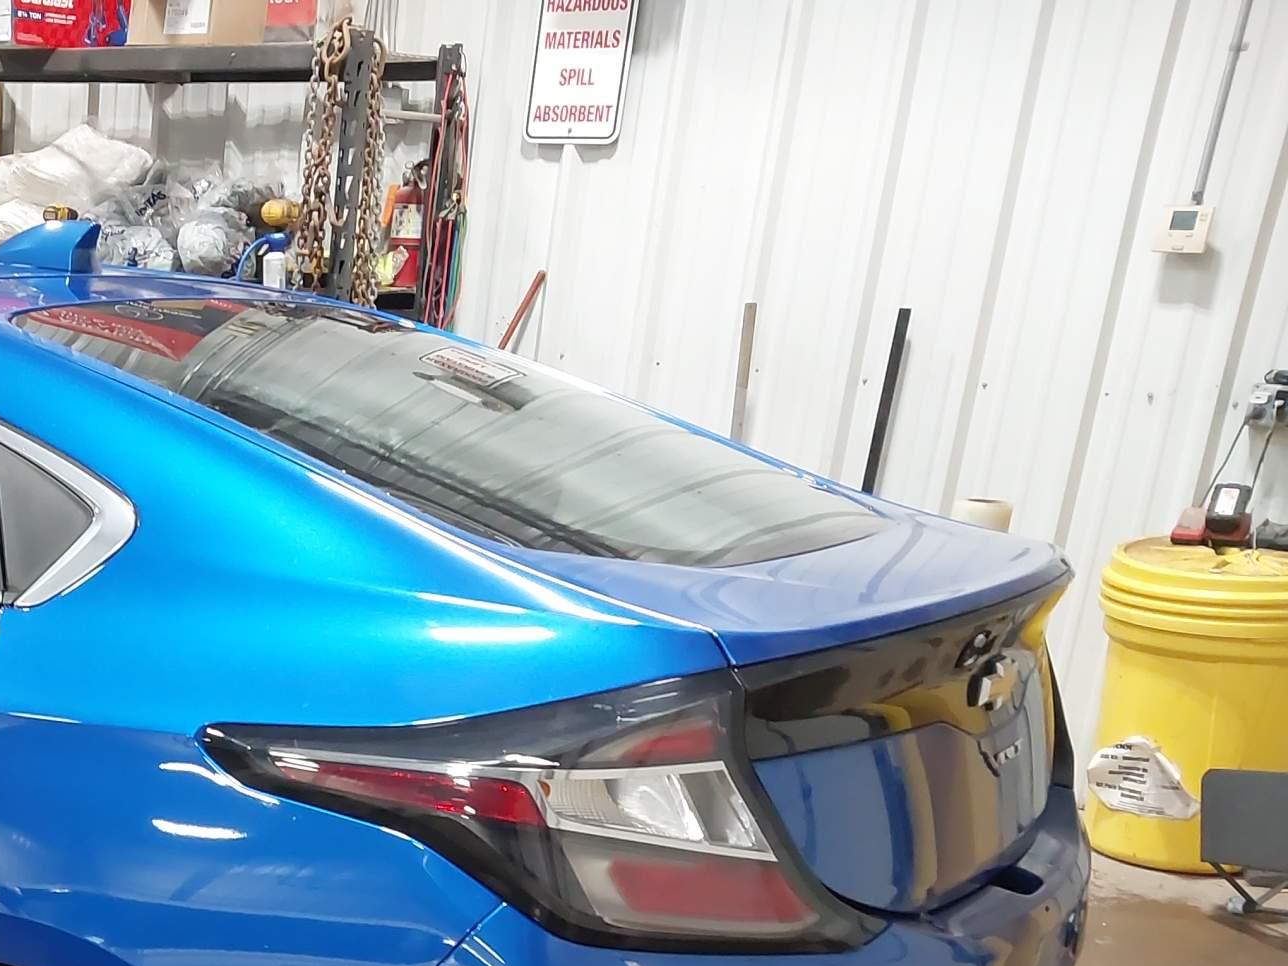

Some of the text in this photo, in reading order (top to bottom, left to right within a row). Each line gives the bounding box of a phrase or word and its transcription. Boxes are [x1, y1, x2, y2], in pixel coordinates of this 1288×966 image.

[544, 29, 621, 49] MATERIALS
[559, 68, 595, 86] SPILL
[533, 105, 613, 122] ABSORBENT
